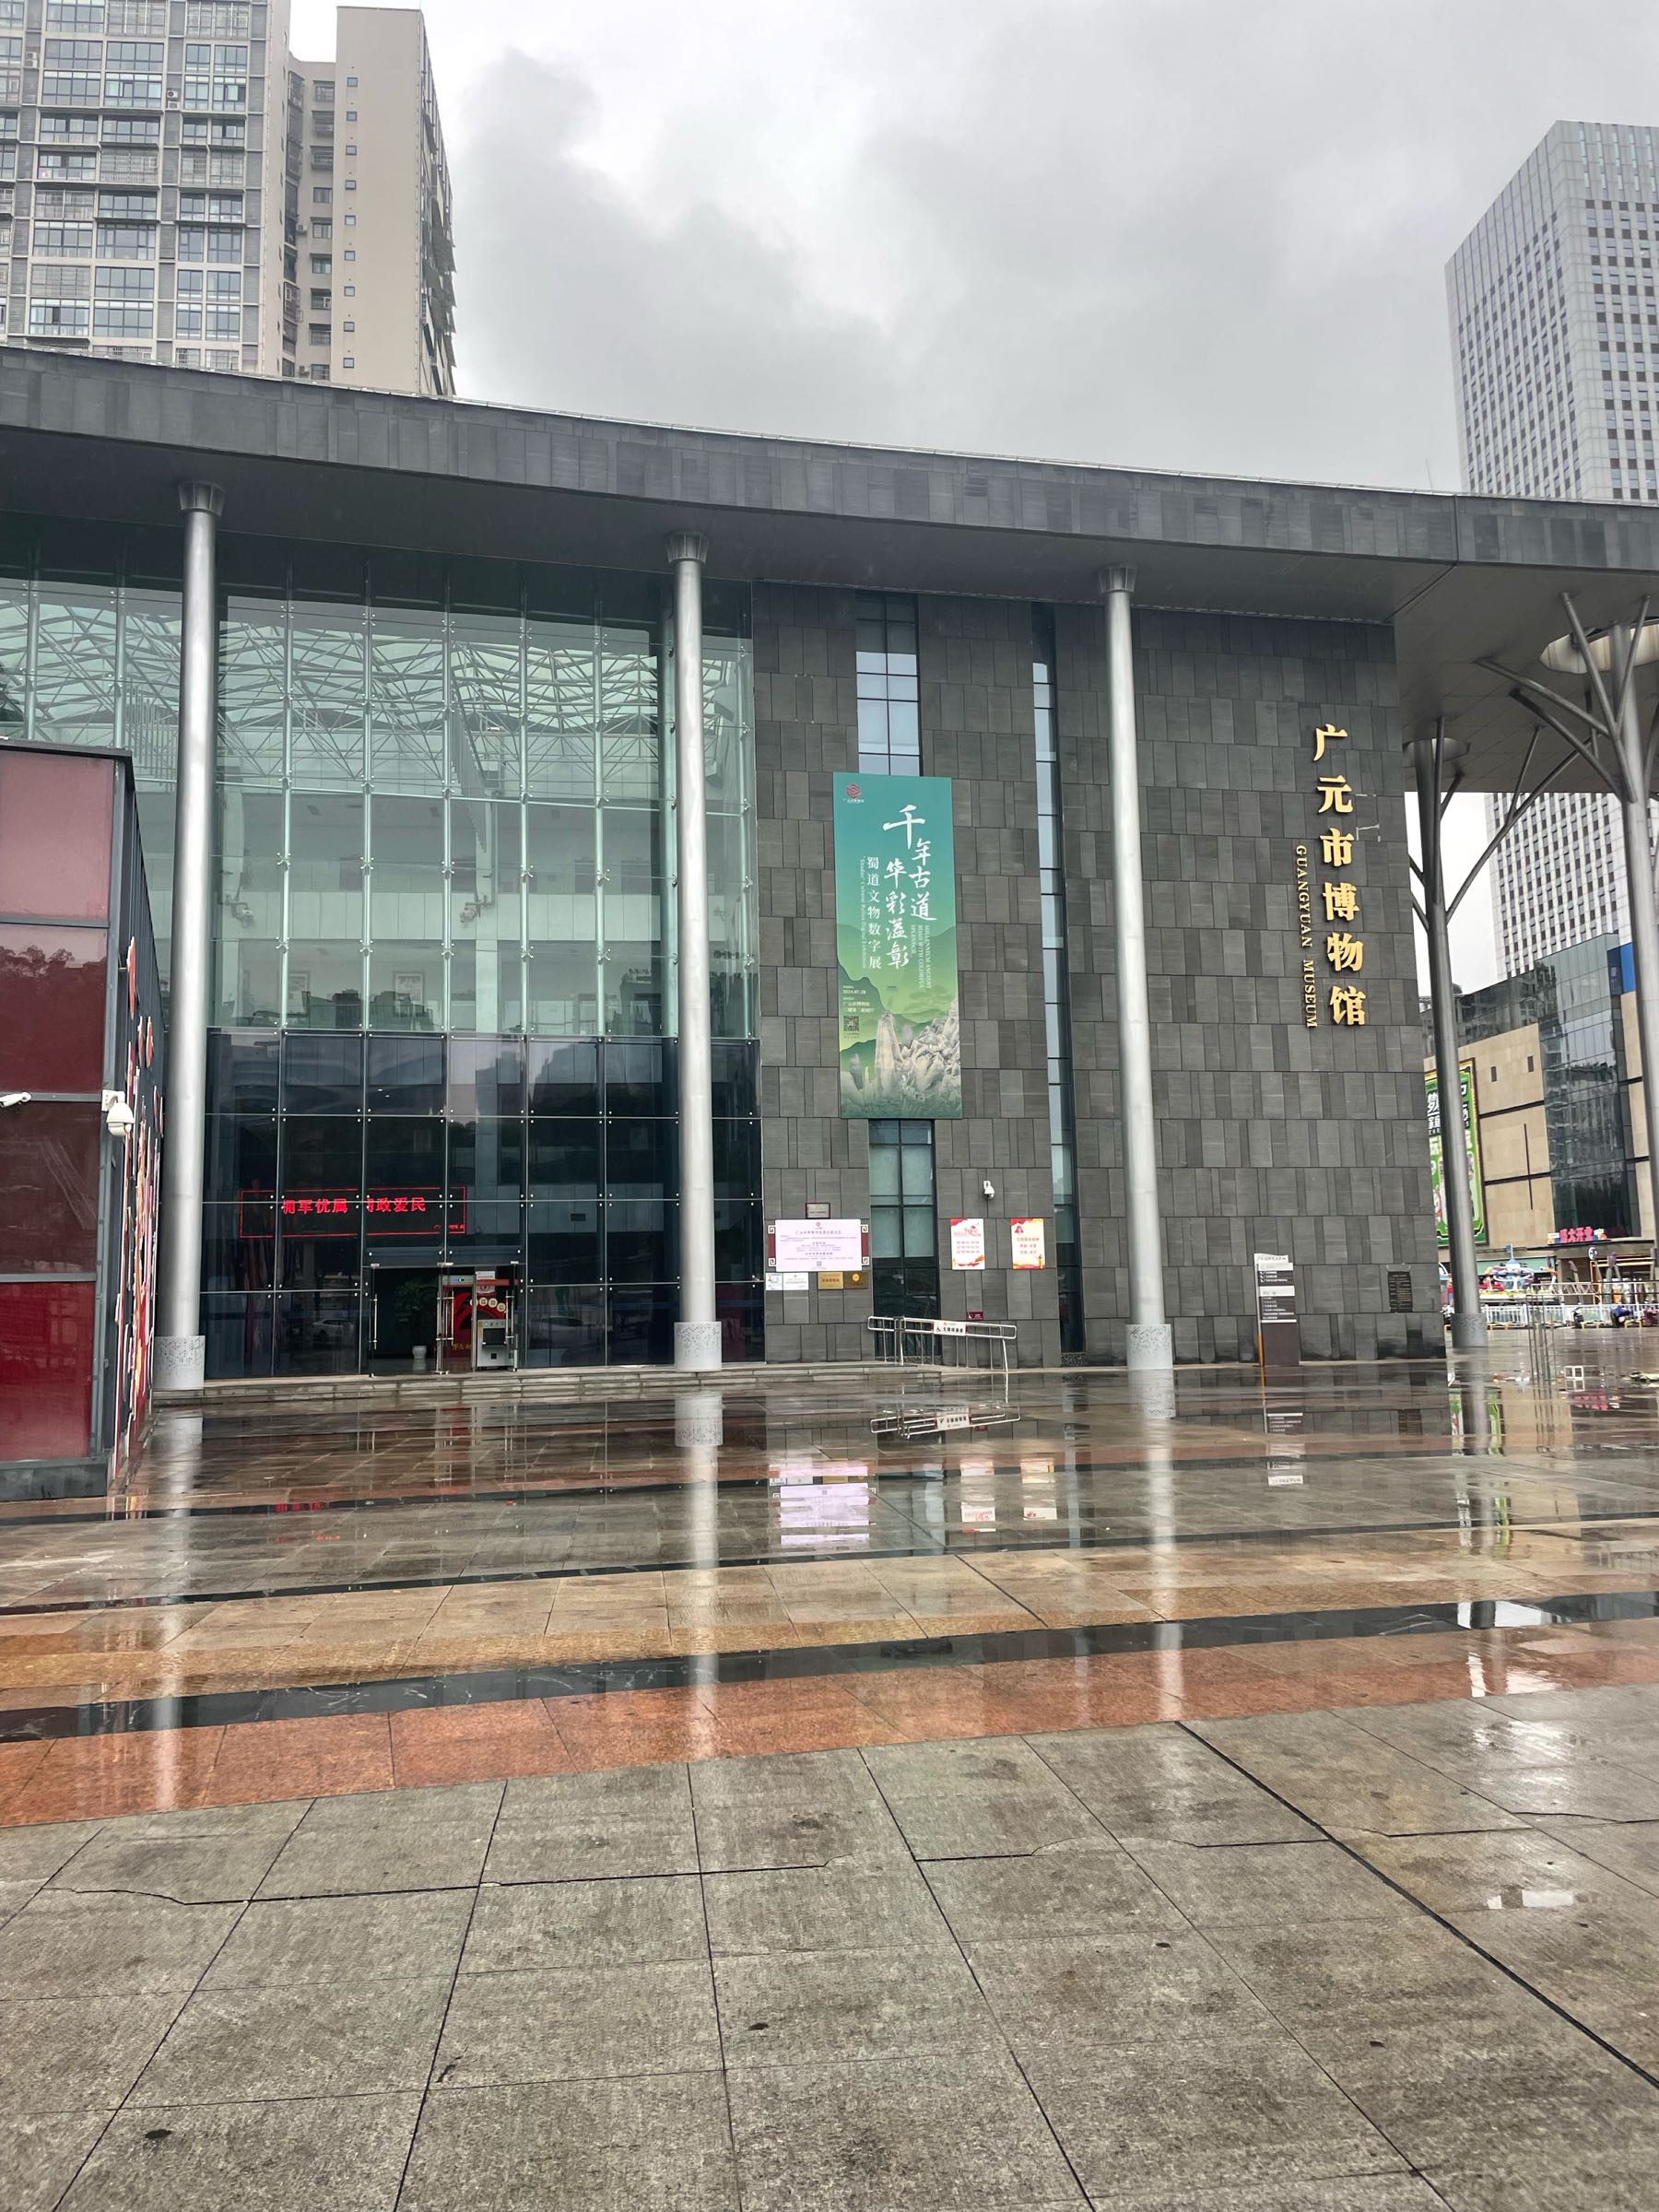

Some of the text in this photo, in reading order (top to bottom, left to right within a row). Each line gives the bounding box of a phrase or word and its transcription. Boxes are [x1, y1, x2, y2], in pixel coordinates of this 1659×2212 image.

[867, 856, 882, 970] 蜀道文物数字展
[882, 804, 937, 921] 千年古道
[883, 857, 910, 970] 华彩溢彰
[1312, 724, 1366, 1026] 广元市博物馆
[1295, 844, 1318, 1028] GUANGYUAN MUSEUM
